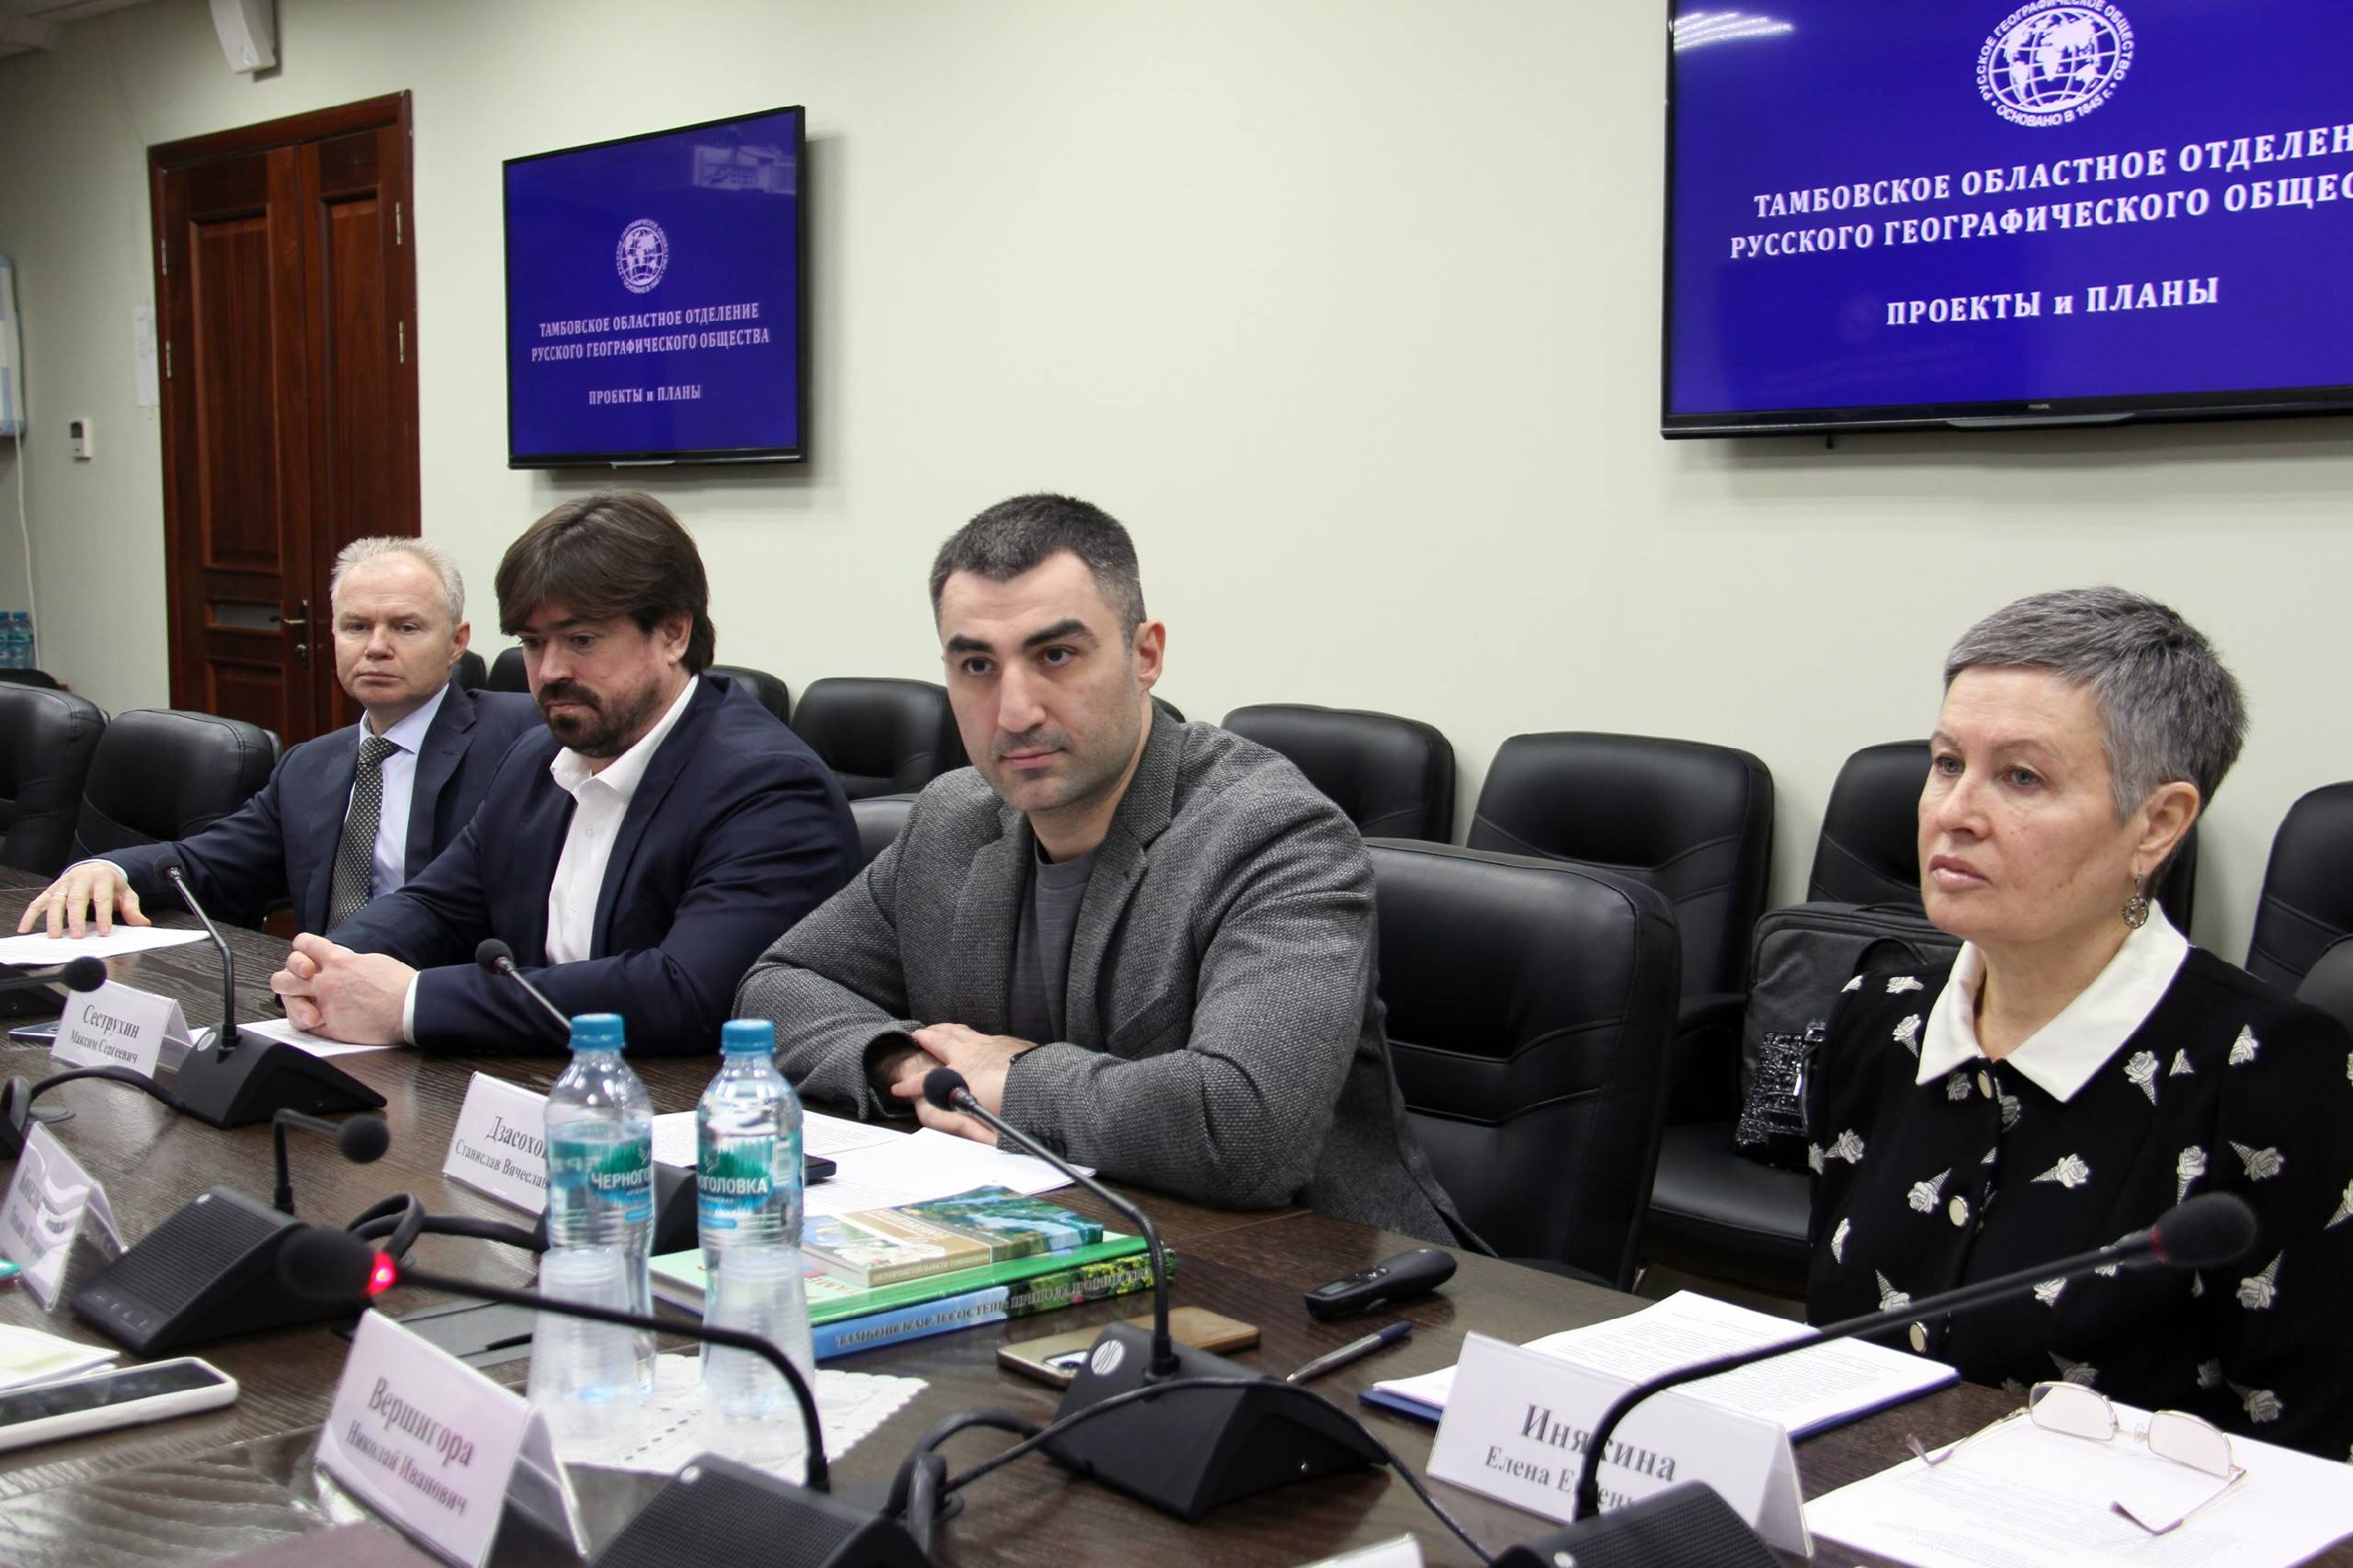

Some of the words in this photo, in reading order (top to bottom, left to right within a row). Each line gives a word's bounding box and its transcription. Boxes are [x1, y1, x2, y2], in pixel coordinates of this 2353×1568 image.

[1976, 35, 1997, 102] РУССКОЕ
[2103, 4, 2135, 82] ОБЩЕСТВО
[1995, 103, 2063, 128] ОСНОВАНО
[2063, 109, 2076, 124] В
[1754, 175, 1950, 217] ТАМБОВСКОЕ
[1961, 149, 2167, 196] ОБЛАСТНОЕ
[2179, 123, 2353, 173] ОТДЕЛЕН
[1731, 223, 1874, 259] РУССКОГО
[1883, 187, 2210, 245] ГЕОГРАФИЧЕСКОГО
[539, 318, 610, 337] ТАМБОВСКОЕ
[612, 311, 682, 331] ОБЛАСТНОЕ
[685, 302, 760, 324] ОТДЕЛЕНИЕ
[1887, 291, 2040, 325] ПРОЕКТЫ
[2053, 296, 2074, 315] и
[2086, 278, 2219, 312] ПЛАНЫ
[531, 343, 584, 362] РУССКОГО
[586, 335, 698, 358] ГЕОГРАФИЧЕСКОГО
[699, 327, 770, 349] ОБЩЕСТВА
[588, 389, 642, 405] ПРОЕКТЫ
[646, 391, 654, 402] и
[657, 384, 701, 401] ПЛАНЫ
[83, 1004, 141, 1039] Сеструхин
[71, 1029, 98, 1051] Максим
[98, 1039, 139, 1063] Сергеевич
[455, 1139, 501, 1171] Станислав
[367, 1376, 475, 1468] Вершигора
[346, 1419, 399, 1471] Николай
[398, 1454, 468, 1516] Иванович
[1484, 1445, 1551, 1486] Елена
